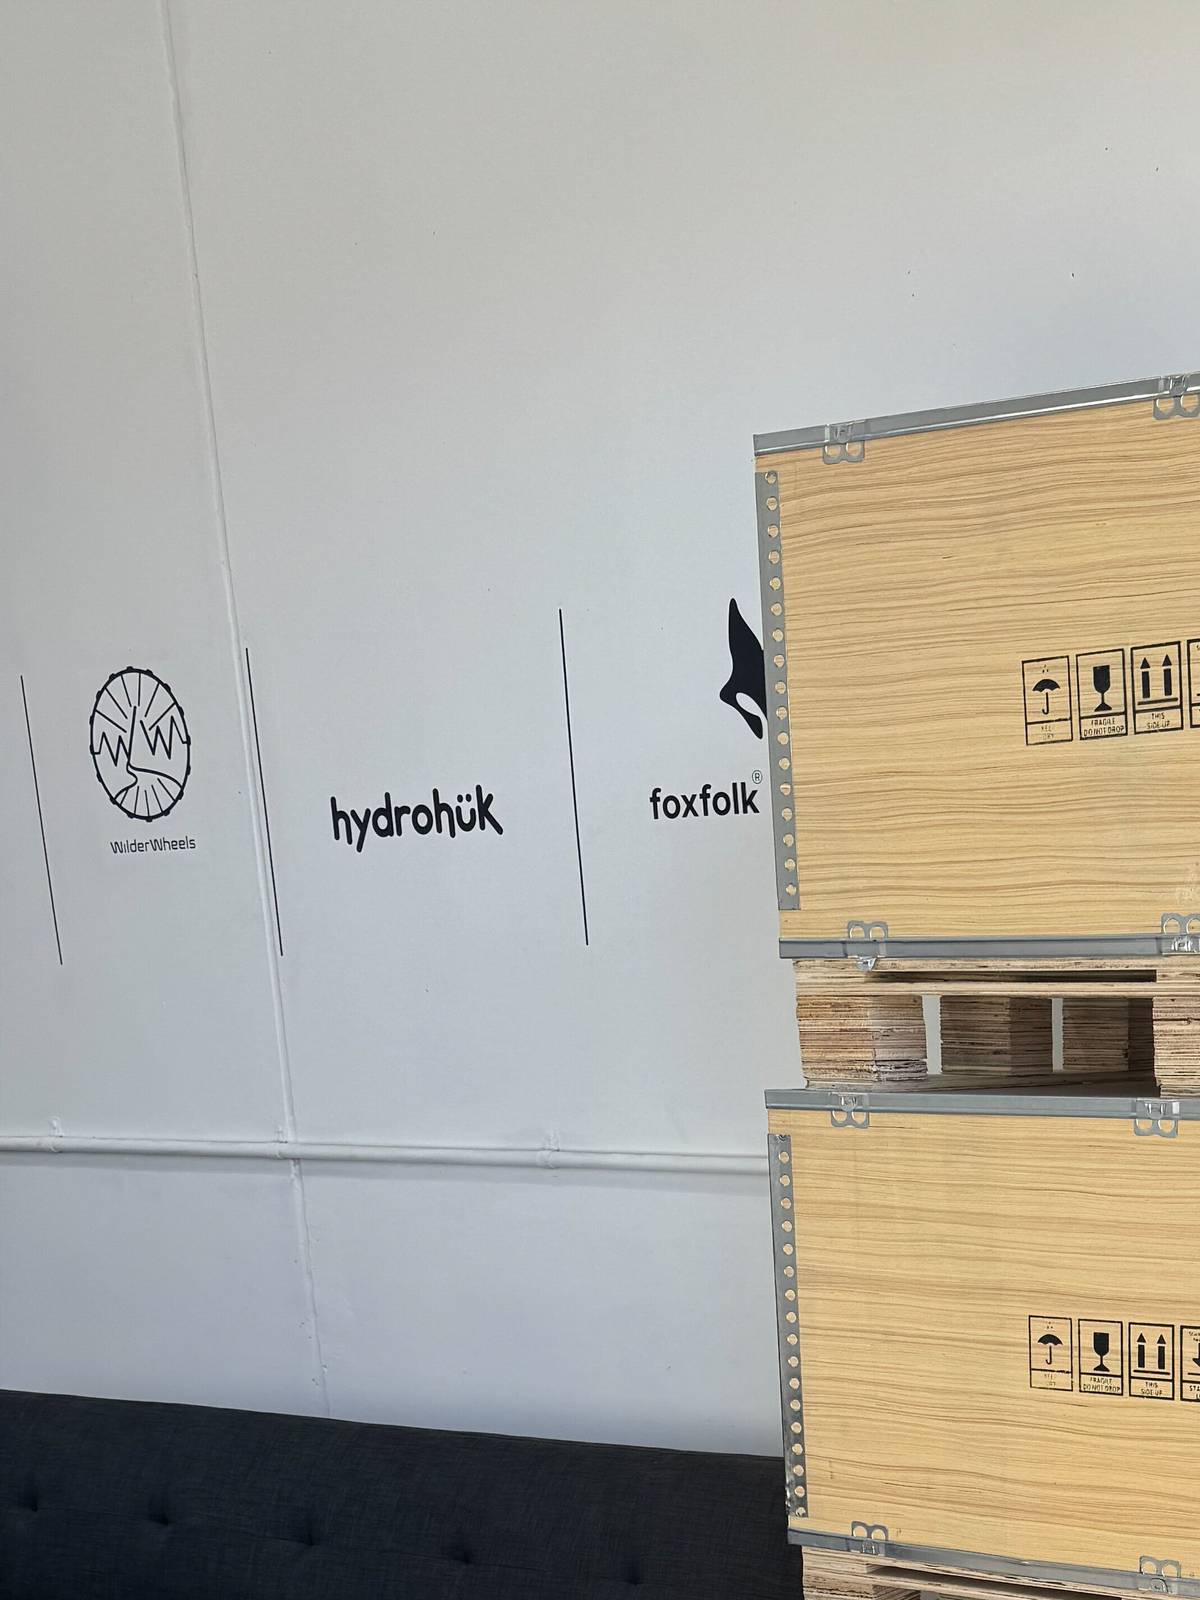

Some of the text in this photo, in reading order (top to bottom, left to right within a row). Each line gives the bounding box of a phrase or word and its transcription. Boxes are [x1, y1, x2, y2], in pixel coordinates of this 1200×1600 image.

[1107, 725, 1125, 734] DROP
[330, 784, 503, 853] hydrohük
[110, 836, 196, 854] WilderWheels
